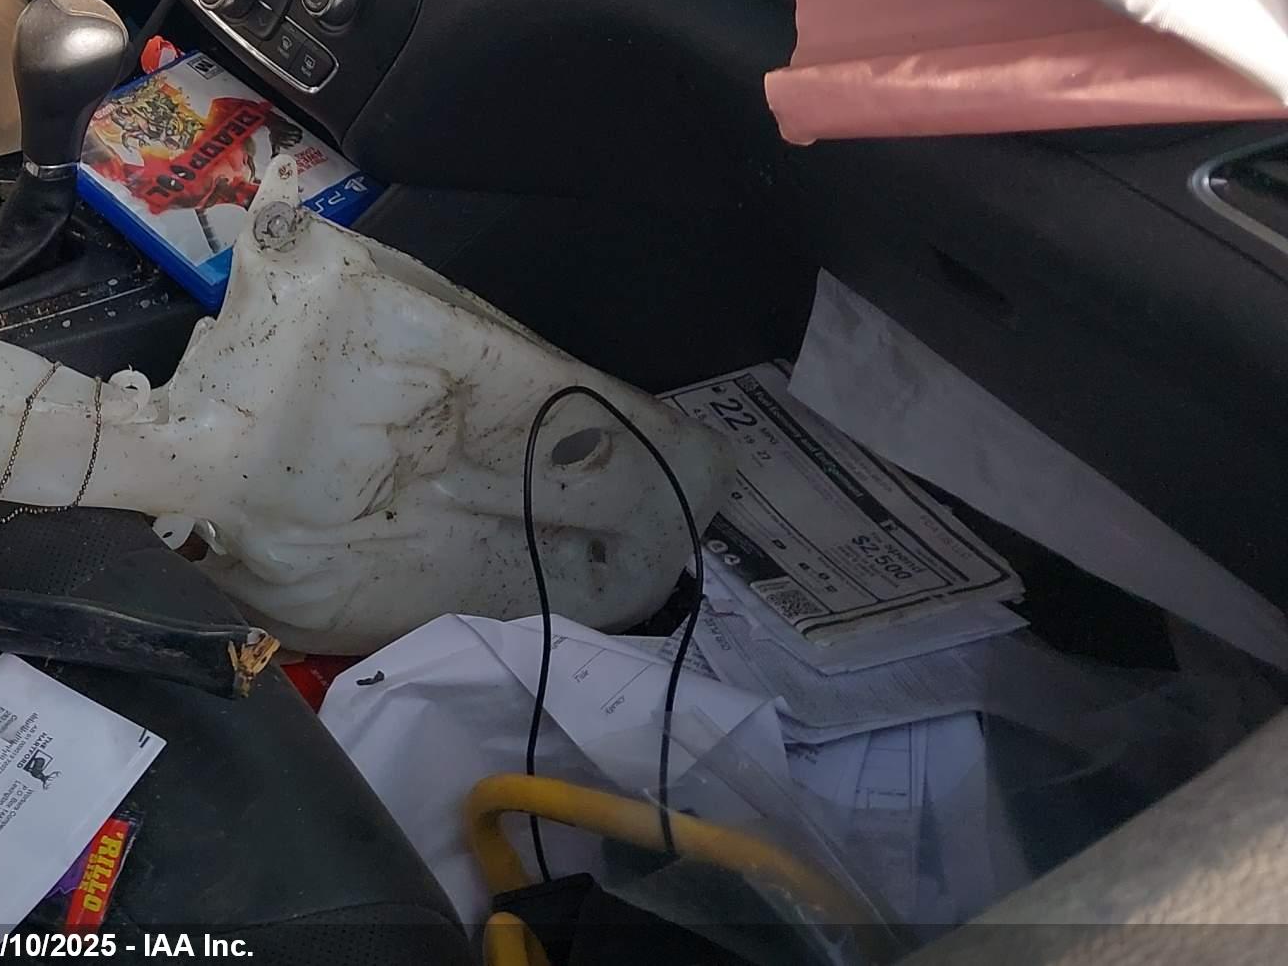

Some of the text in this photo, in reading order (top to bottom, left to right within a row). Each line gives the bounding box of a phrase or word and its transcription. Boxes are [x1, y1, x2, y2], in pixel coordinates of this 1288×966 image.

[146, 107, 261, 198] DEADPOOL
[709, 397, 758, 432] 22
[851, 534, 914, 580] $2,500
[16, 730, 46, 769] HARTFORD
[39, 734, 52, 749] THE
